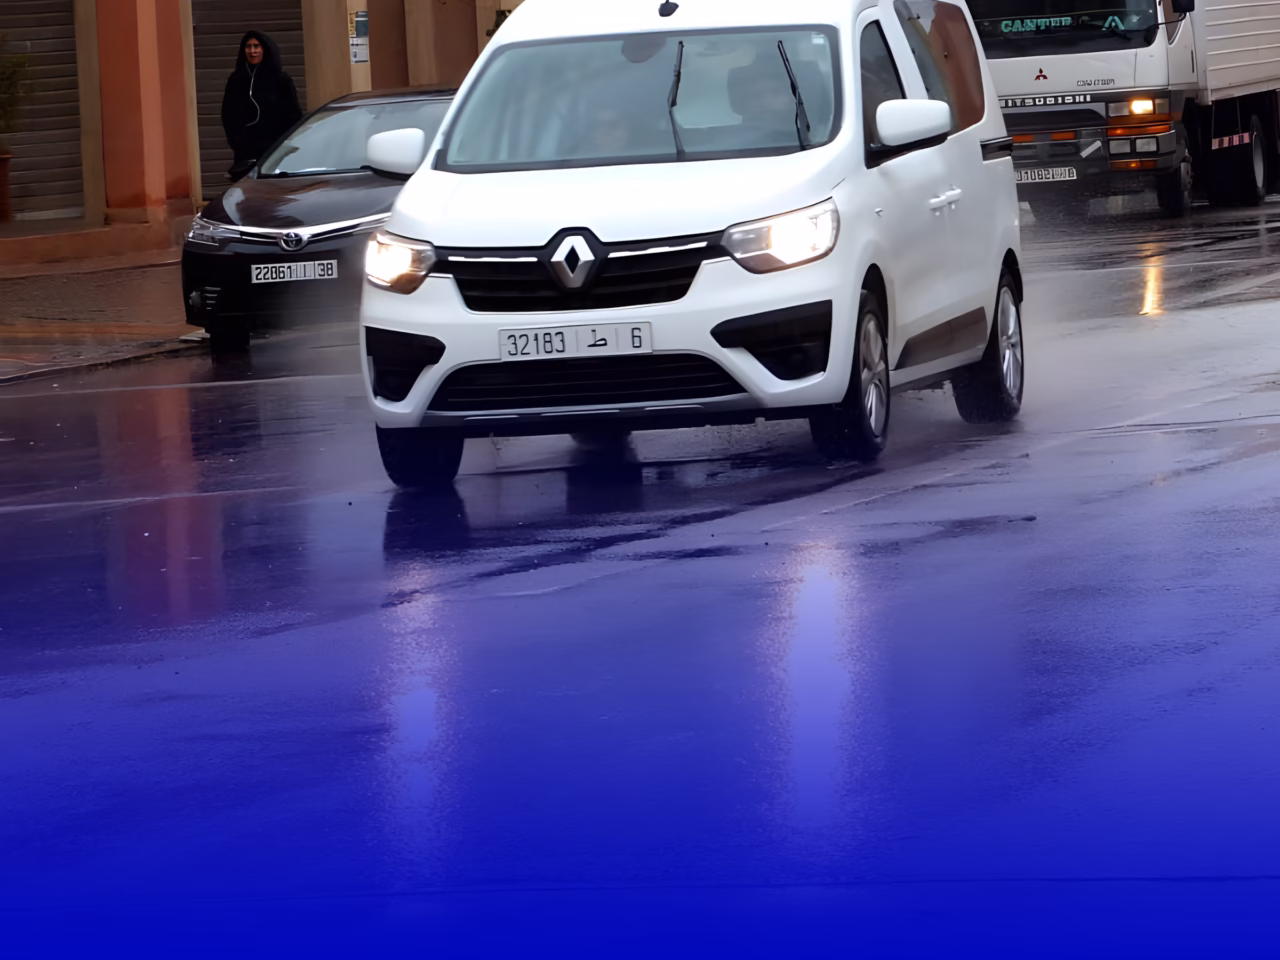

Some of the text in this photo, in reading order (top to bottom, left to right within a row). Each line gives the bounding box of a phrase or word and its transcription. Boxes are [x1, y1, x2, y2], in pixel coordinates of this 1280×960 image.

[317, 262, 334, 278] 38
[507, 331, 566, 356] 32183
[631, 327, 642, 348] 6
